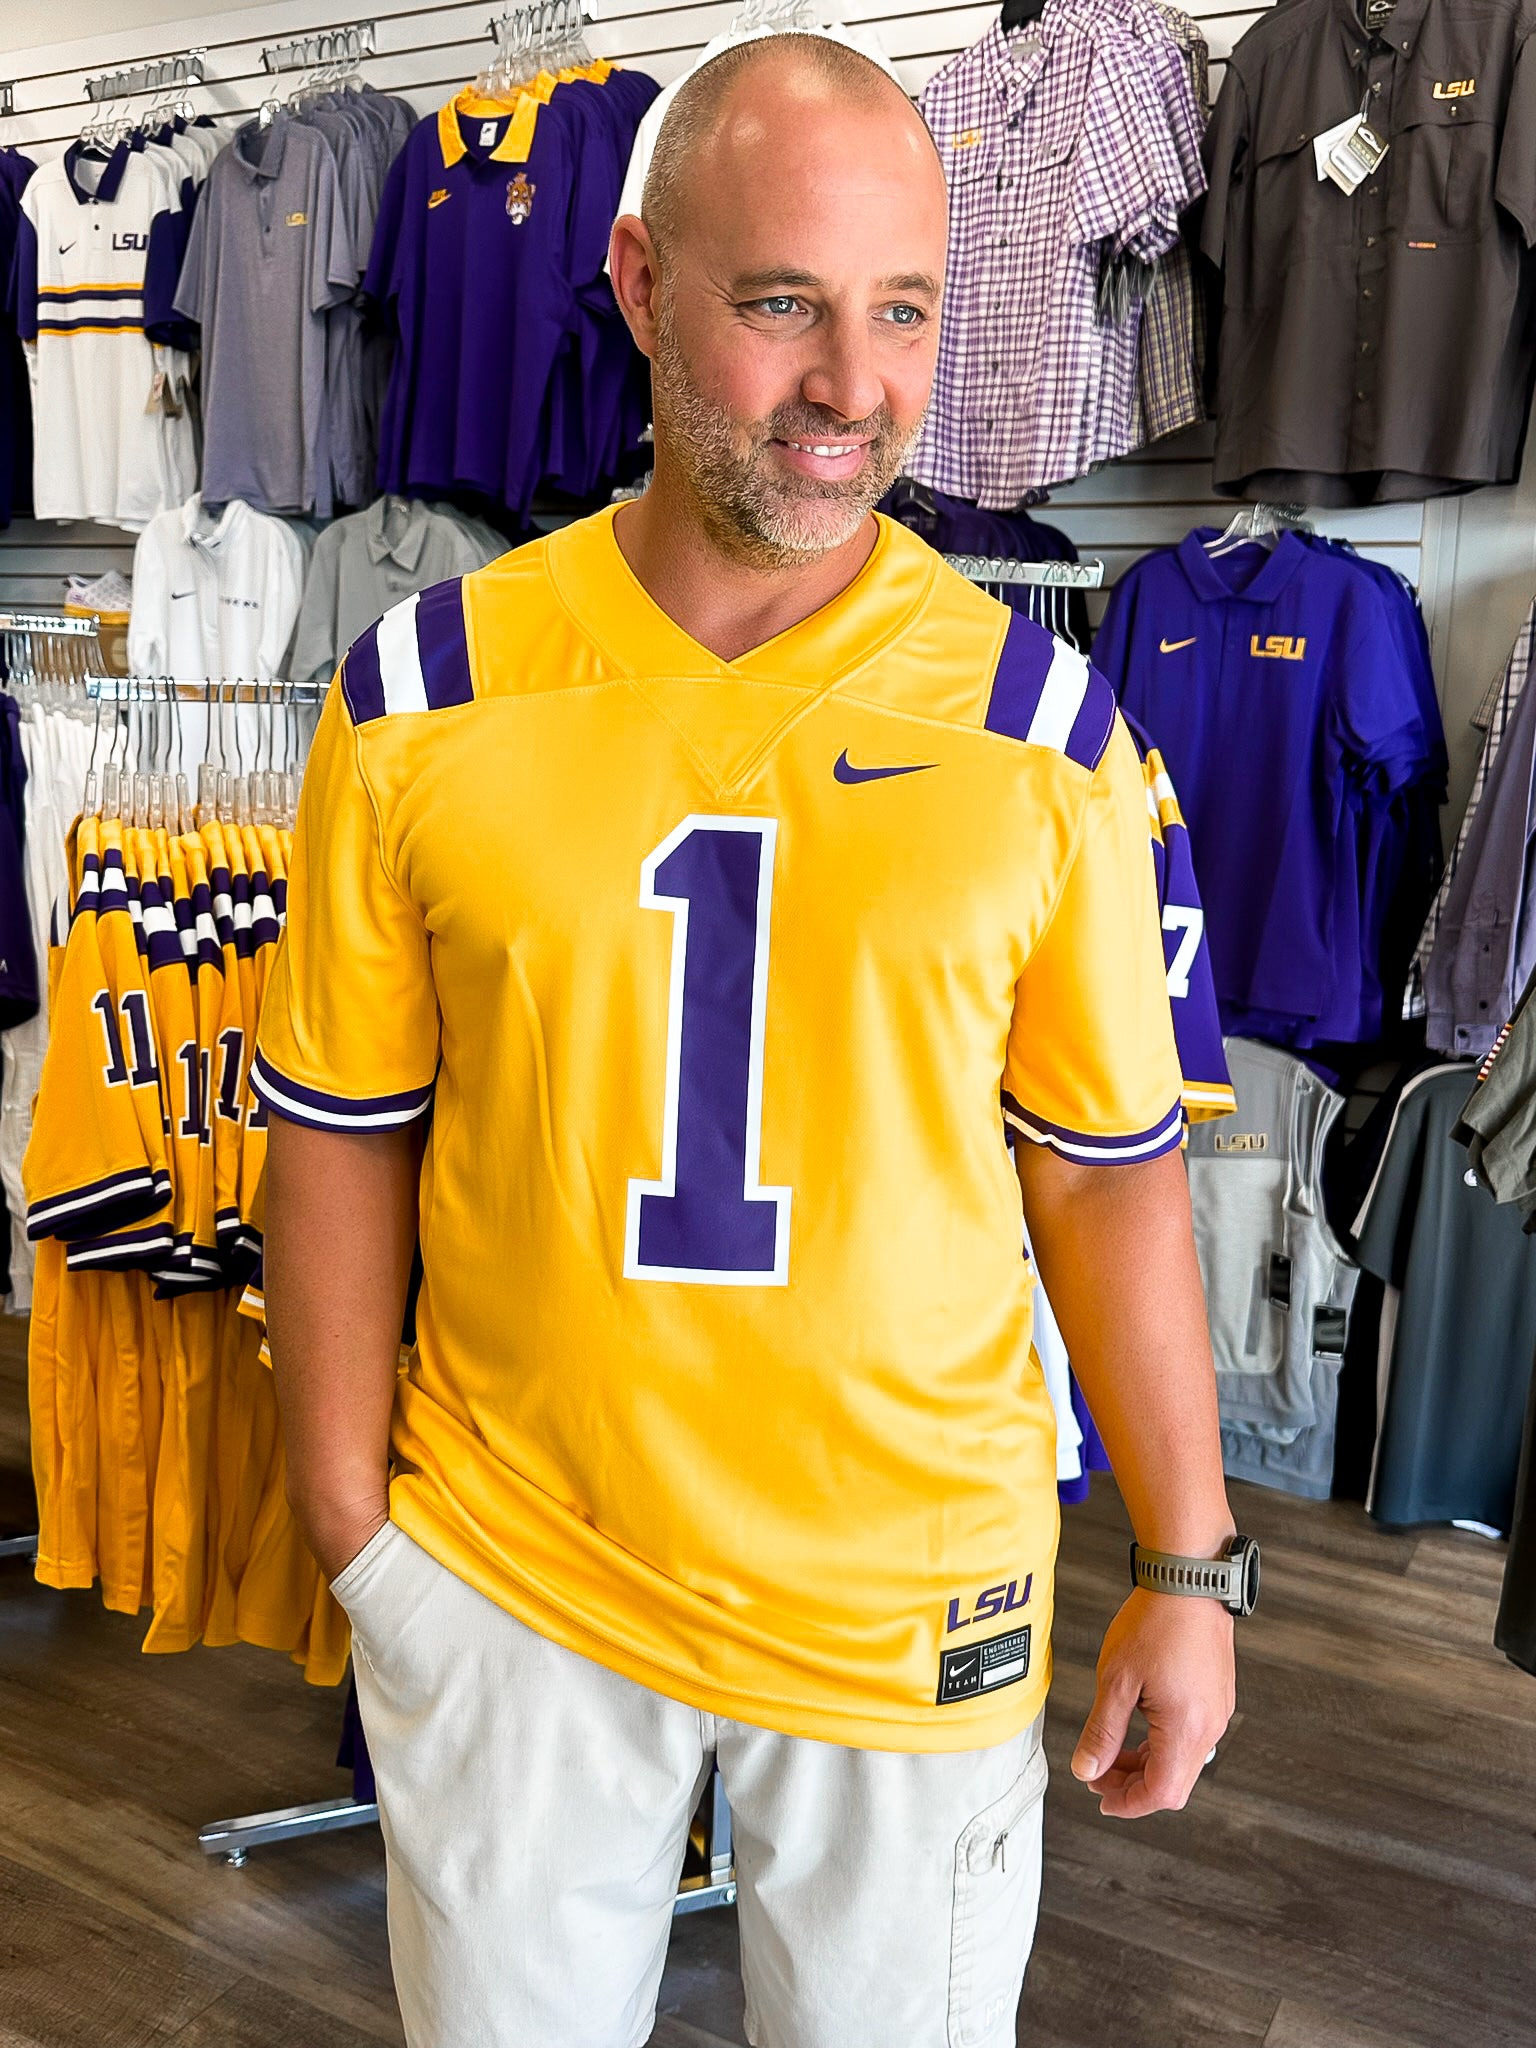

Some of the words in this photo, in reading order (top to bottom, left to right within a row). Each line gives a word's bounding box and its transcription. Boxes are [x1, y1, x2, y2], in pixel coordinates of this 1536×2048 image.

[1433, 79, 1475, 99] LSU
[112, 233, 149, 250] LSU
[1250, 634, 1306, 661] LSU
[1161, 904, 1204, 998] 7
[623, 814, 792, 1286] 1
[1215, 1133, 1268, 1152] LSU
[946, 1572, 1033, 1634] LSU
[983, 1635, 1026, 1656] ENGINEERED
[948, 1675, 977, 1690] TEAM
